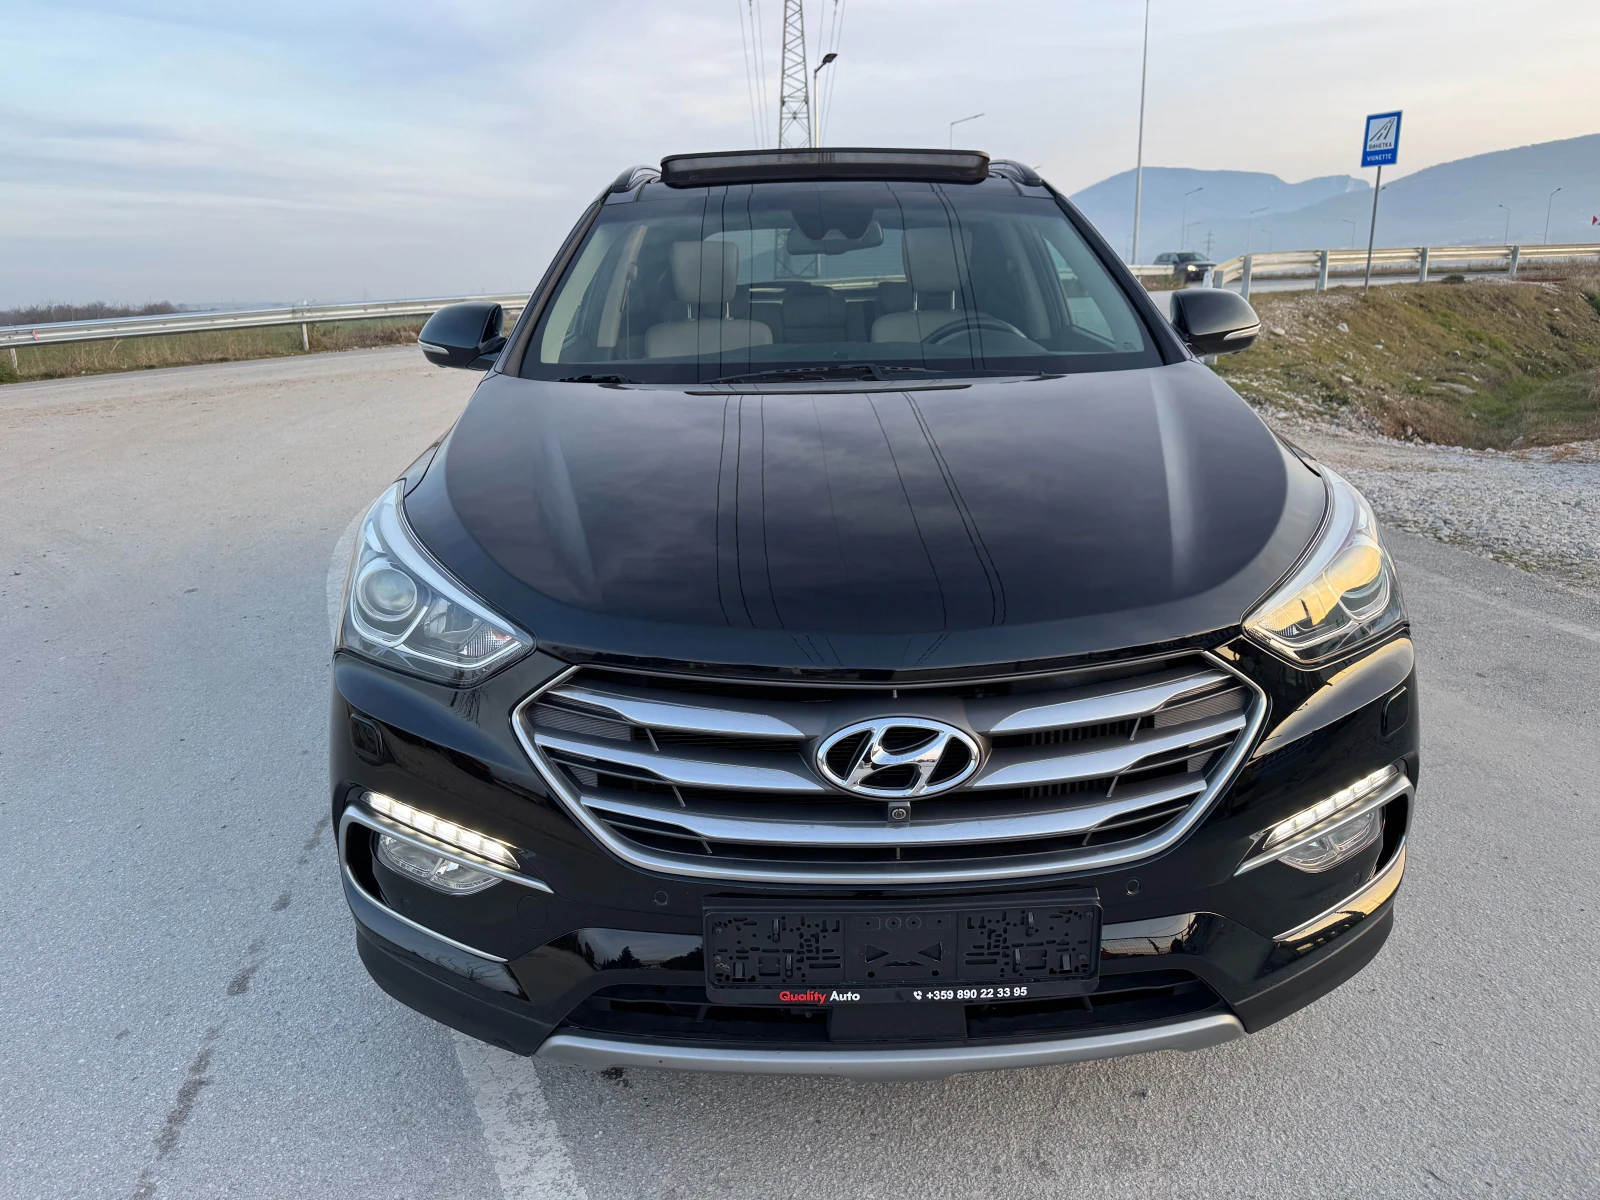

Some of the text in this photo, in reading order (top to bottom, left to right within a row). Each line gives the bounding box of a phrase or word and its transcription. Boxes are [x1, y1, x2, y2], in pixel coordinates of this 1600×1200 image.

[1367, 153, 1391, 161] VIGNETTE
[779, 989, 861, 1005] Quality Auto
[926, 986, 1027, 1000] +359 890 22 33 95
